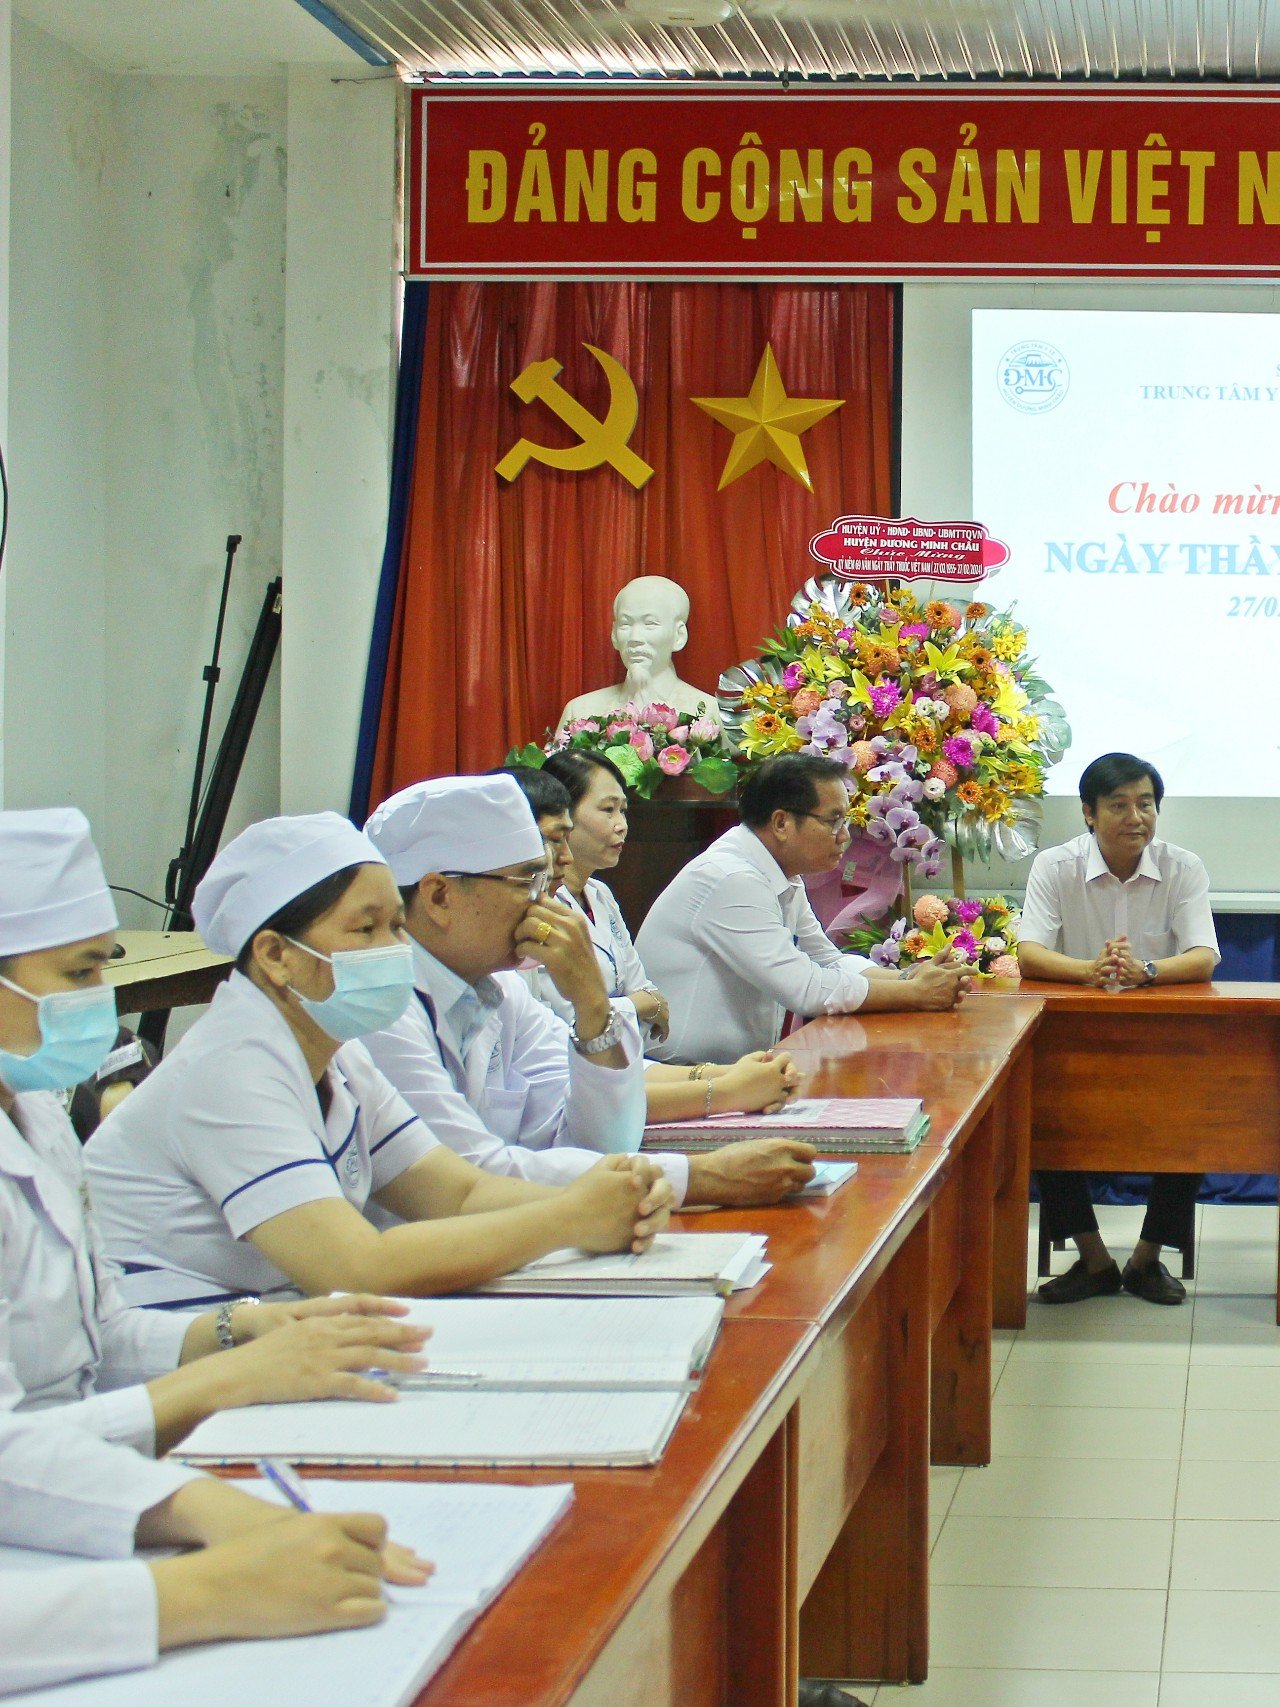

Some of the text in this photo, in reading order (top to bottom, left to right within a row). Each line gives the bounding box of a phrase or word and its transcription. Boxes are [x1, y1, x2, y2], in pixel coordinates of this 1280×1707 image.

[465, 122, 657, 223] ĐẢNG
[682, 132, 872, 239] CỘNG
[897, 122, 1041, 225] SẢN
[1064, 133, 1215, 243] VIỆT
[1140, 385, 1210, 401] TRUNG
[1215, 382, 1260, 401] TÂM
[1265, 387, 1278, 401] Y
[1108, 481, 1200, 514] Chào
[842, 523, 868, 537] HUYỆN
[938, 529, 982, 541] UBMTTQVN
[844, 537, 980, 552] HUYỆN DƯƠNG MINH CHÂU
[1044, 533, 1171, 574] NGÀY
